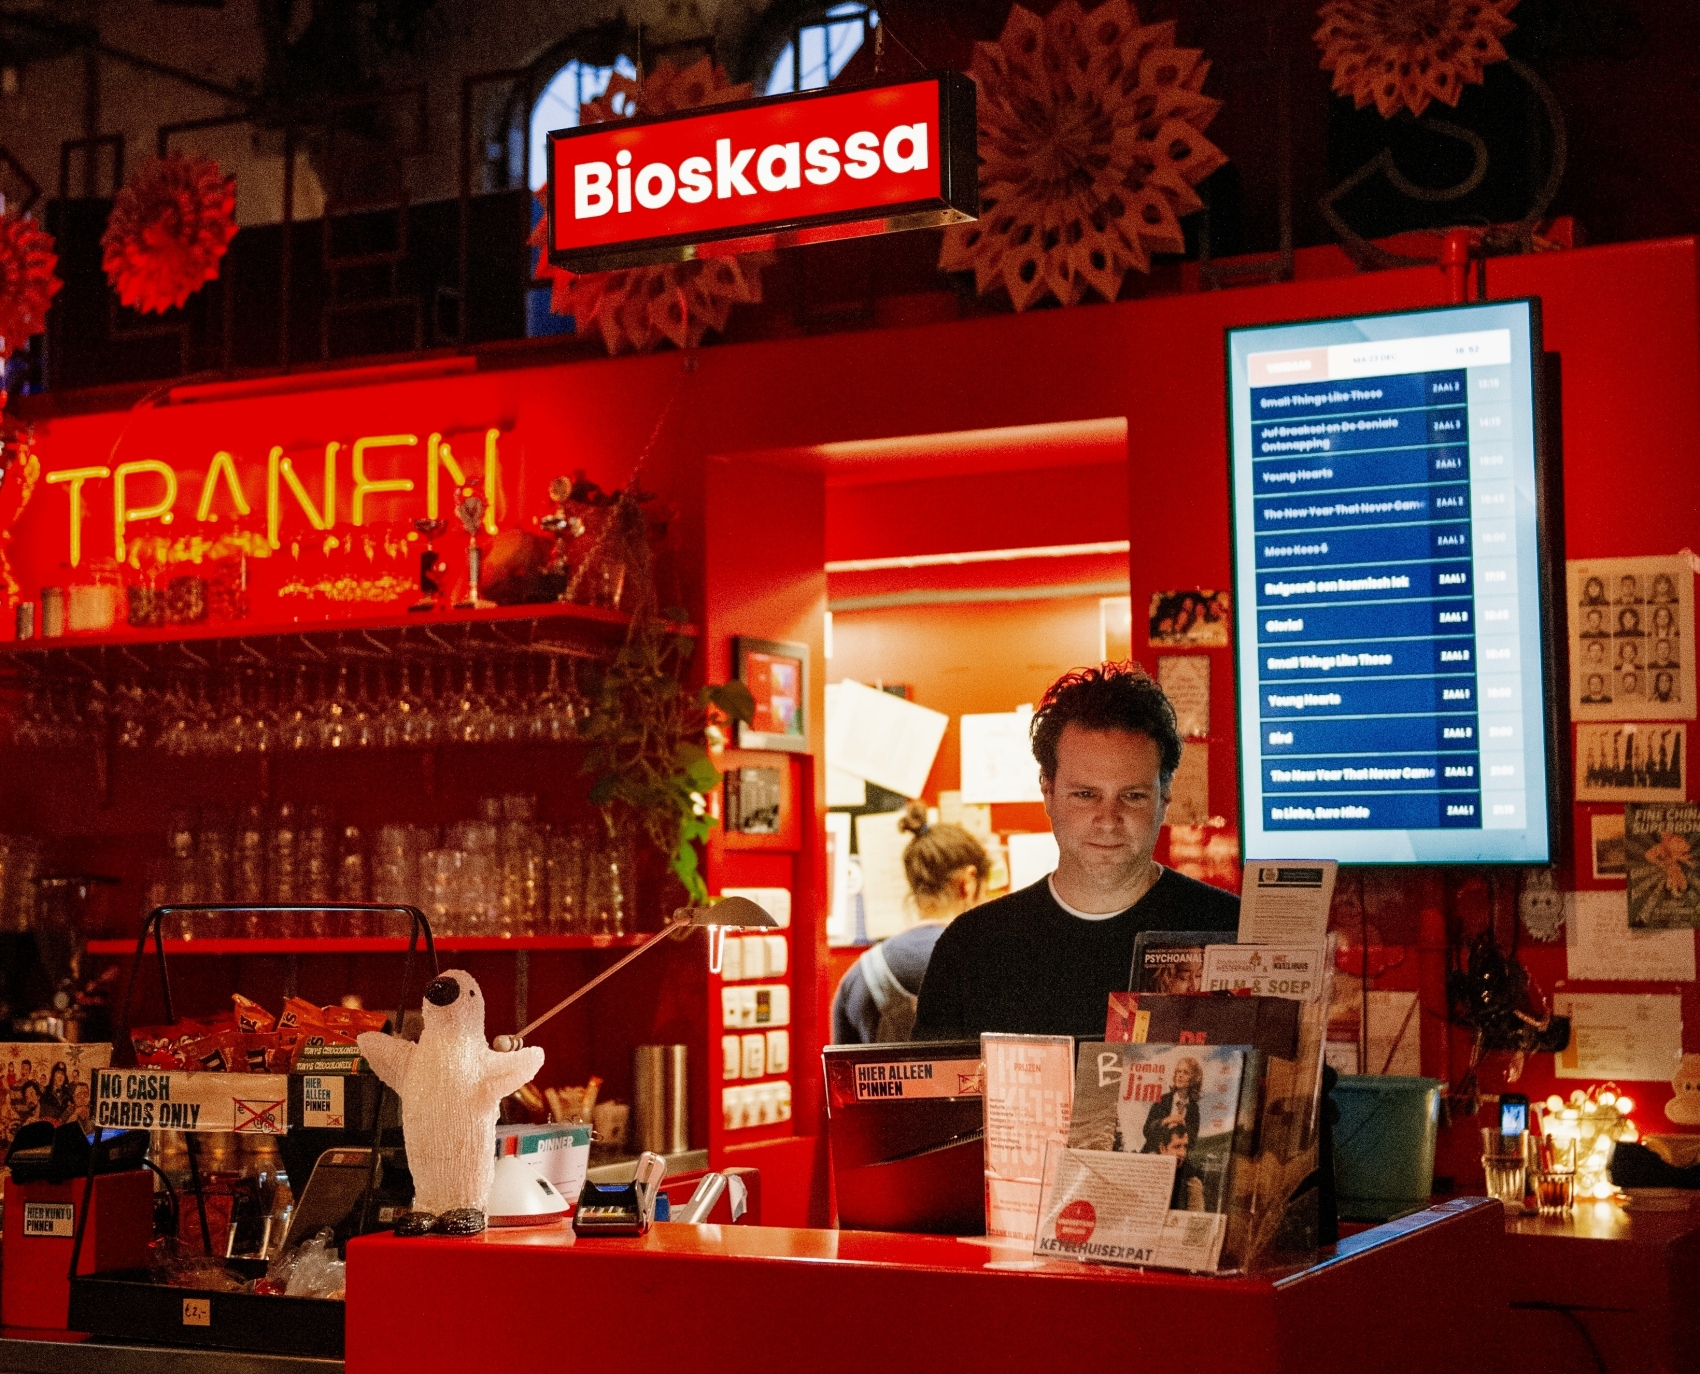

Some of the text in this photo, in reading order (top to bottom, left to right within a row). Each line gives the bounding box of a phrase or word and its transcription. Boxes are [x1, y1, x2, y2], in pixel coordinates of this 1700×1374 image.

[574, 122, 929, 219] Bioskassa
[1260, 388, 1384, 409] Small Things Like These
[1262, 467, 1334, 484] Young Hearts
[1263, 508, 1284, 520] The
[1284, 507, 1308, 519] New
[1308, 505, 1335, 518] Year
[1335, 503, 1360, 516] That
[1361, 501, 1394, 514] Never
[1267, 652, 1393, 671] Small Things Like These
[1267, 692, 1342, 709] Young Hearts
[1270, 769, 1292, 782] The
[1291, 768, 1316, 781] New
[1316, 768, 1342, 781] Year
[1342, 767, 1369, 780] That
[1368, 766, 1402, 780] Never
[1271, 807, 1284, 820] In
[1145, 953, 1204, 964] PSYCHOANAL
[1267, 980, 1312, 994] SOEP
[858, 1063, 933, 1081] HIER ALLEEN
[99, 1075, 171, 1101] NO CASH
[305, 1077, 322, 1089] HIER
[858, 1081, 904, 1098] PINNEN
[1122, 1072, 1164, 1103] Jim
[305, 1088, 331, 1100] ALLEEN
[305, 1100, 331, 1112] PINNEN
[98, 1102, 201, 1130] CARDS ONLY
[537, 1135, 574, 1152] DINNER
[26, 1219, 54, 1232] PINNEN
